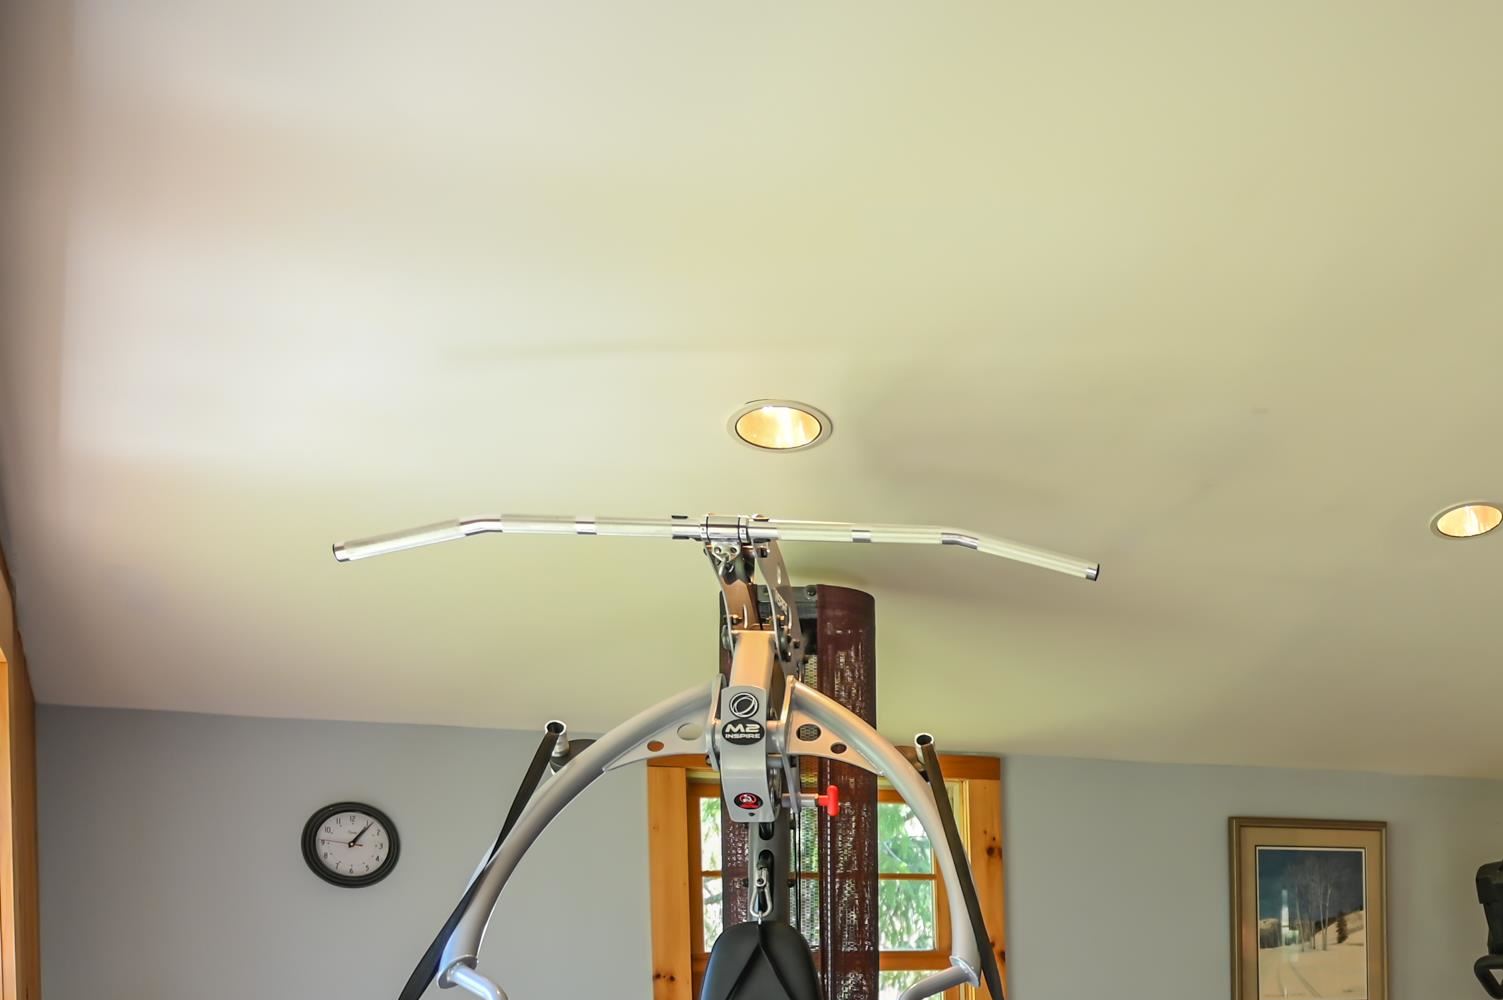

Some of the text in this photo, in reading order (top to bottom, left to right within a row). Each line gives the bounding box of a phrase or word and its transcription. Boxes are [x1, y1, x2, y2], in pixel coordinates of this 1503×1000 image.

[725, 723, 760, 733] M2
[349, 815, 356, 823] 12
[324, 825, 332, 833] 10
